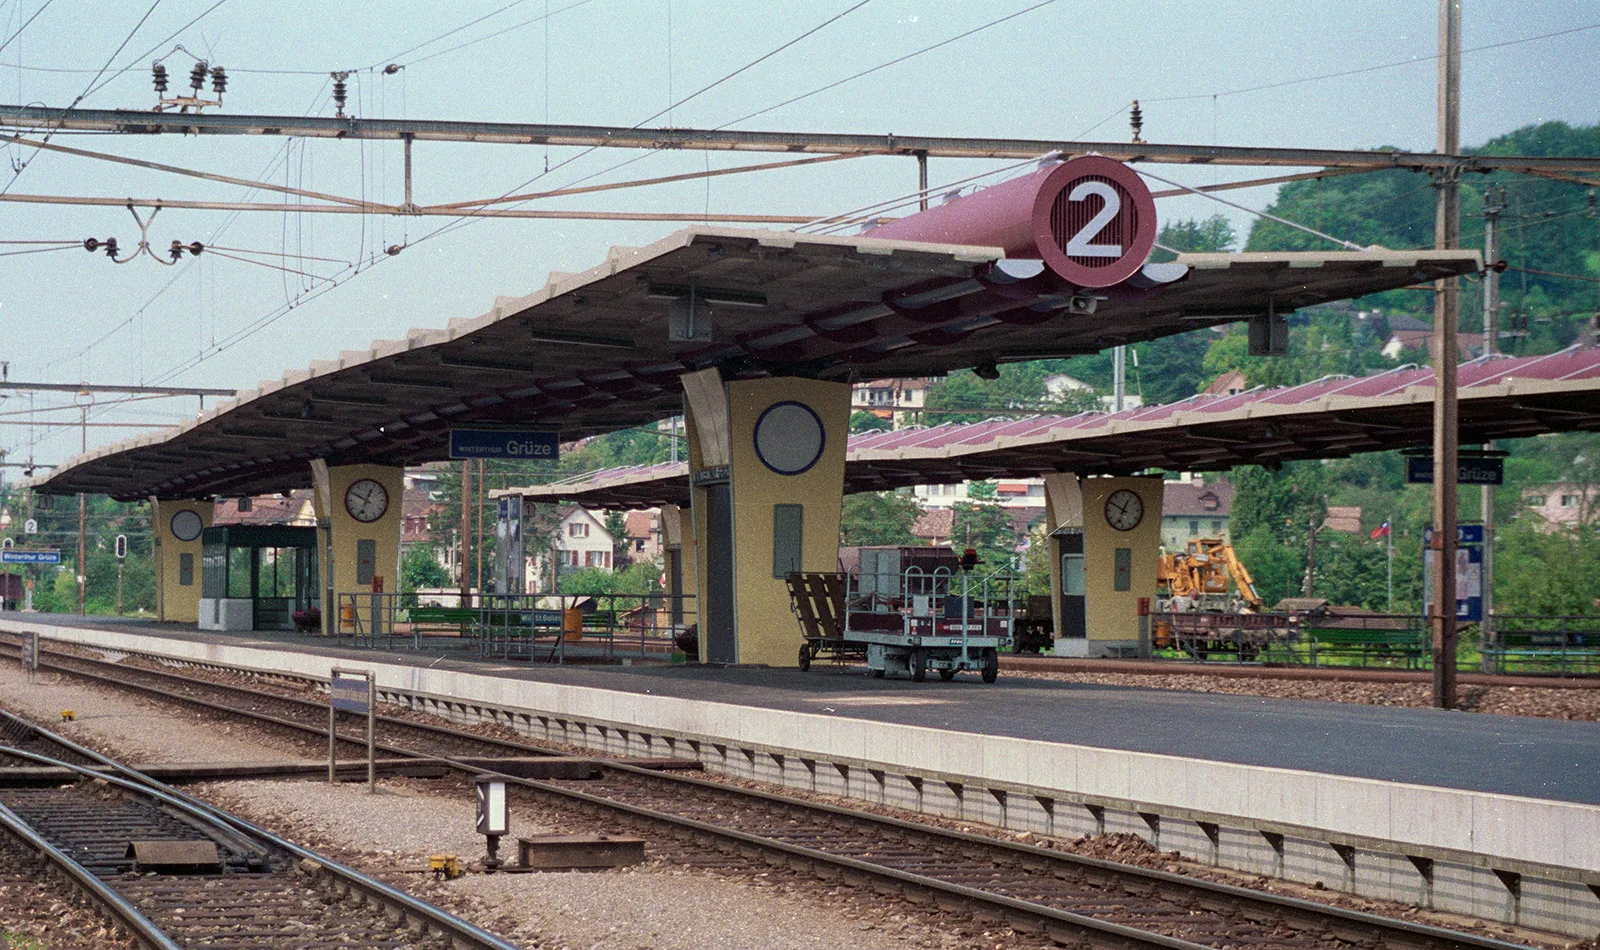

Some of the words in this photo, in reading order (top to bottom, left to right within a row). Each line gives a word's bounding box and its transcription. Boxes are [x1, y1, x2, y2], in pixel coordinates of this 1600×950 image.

[1066, 181, 1122, 258] 2
[458, 446, 503, 454] WINTERTHUR
[506, 440, 551, 456] Grüze
[28, 521, 35, 532] 2
